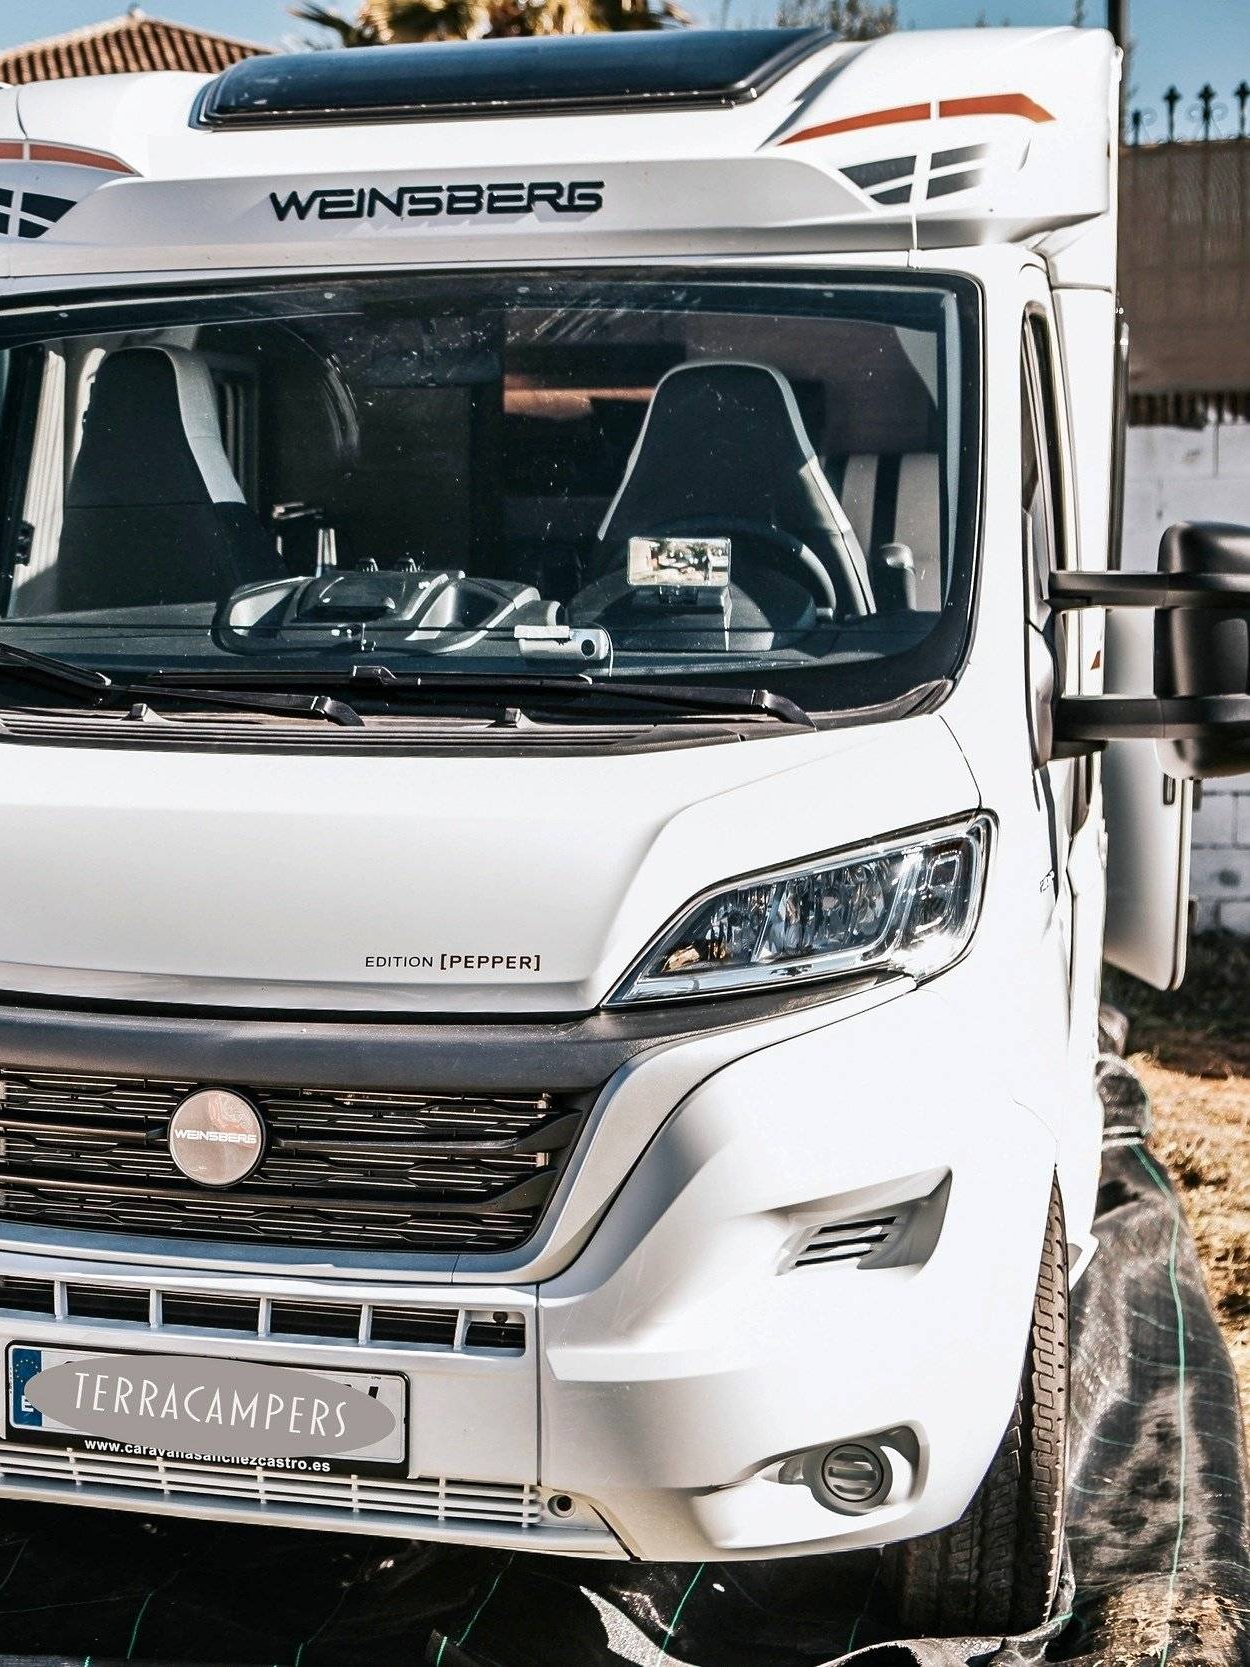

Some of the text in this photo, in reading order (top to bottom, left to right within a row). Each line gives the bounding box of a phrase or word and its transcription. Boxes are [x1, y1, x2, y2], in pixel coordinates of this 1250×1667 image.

[269, 180, 605, 221] WEINSBERG
[365, 953, 541, 972] EDITION [PEPPER]
[174, 1129, 258, 1144] WEINSBERG
